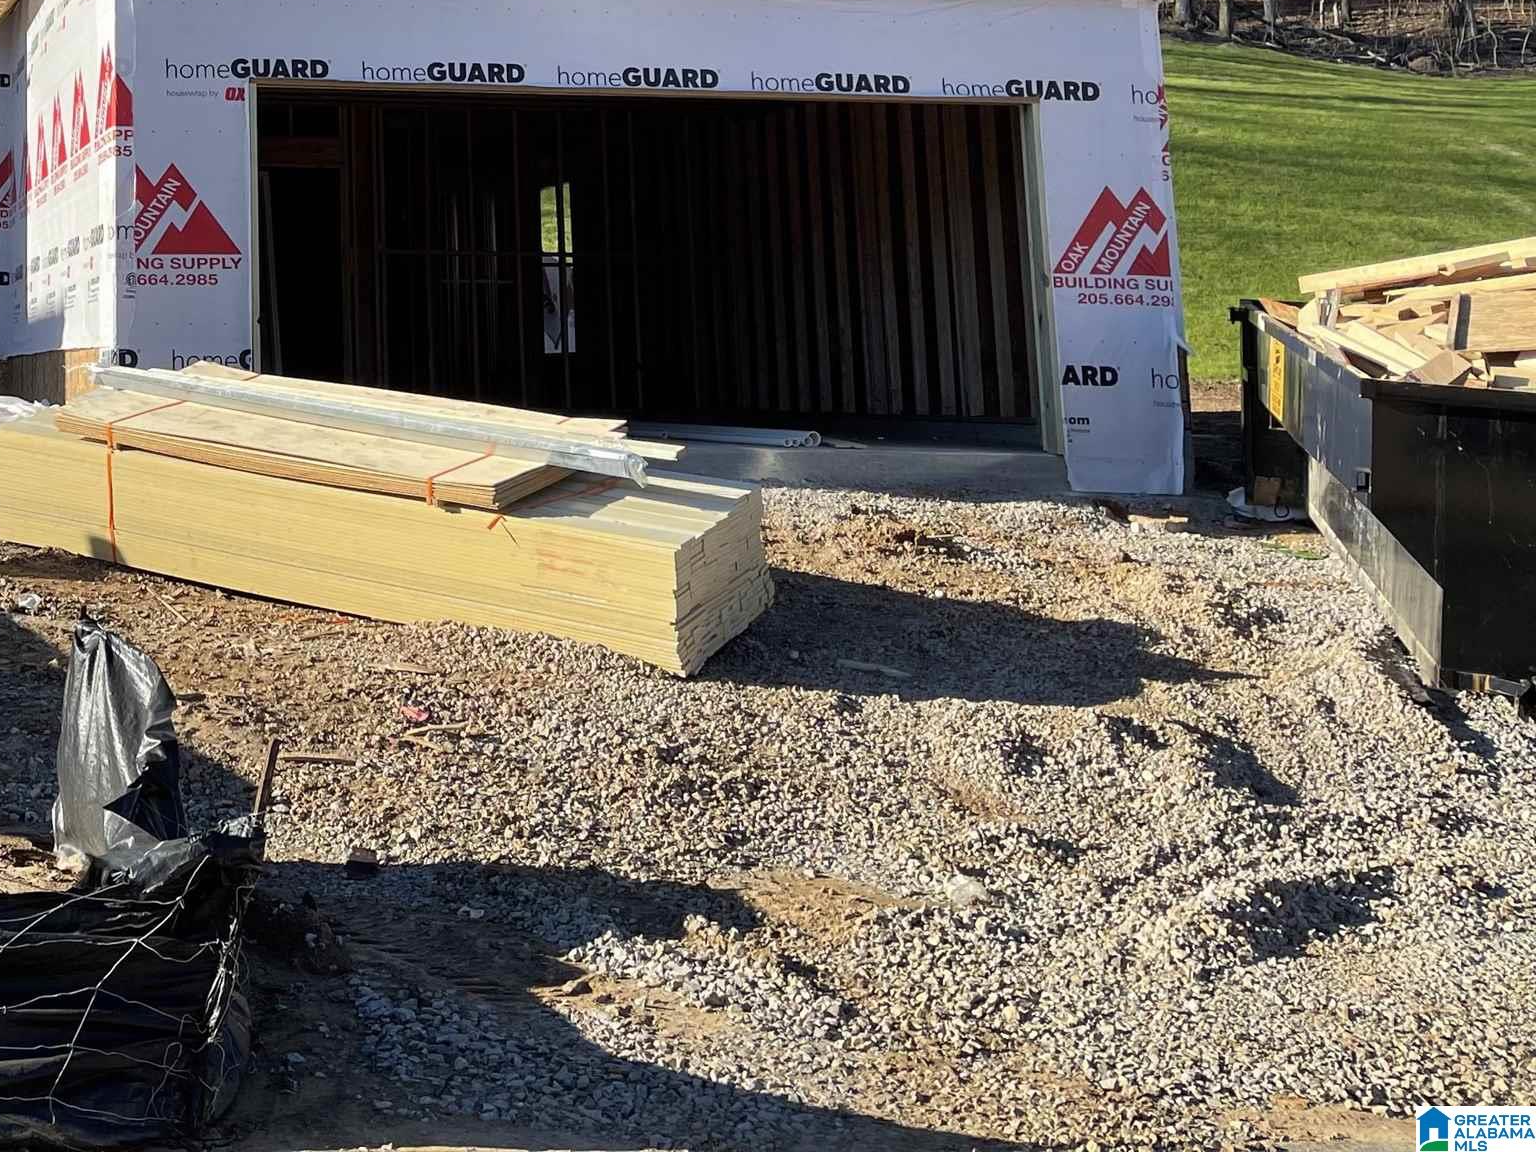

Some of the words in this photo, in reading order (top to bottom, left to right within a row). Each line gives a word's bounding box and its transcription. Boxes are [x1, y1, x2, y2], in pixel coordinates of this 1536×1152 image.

[165, 58, 330, 80] homeGUARD
[362, 61, 526, 83] homeGUARD
[557, 66, 719, 88] homeGUARD
[751, 72, 910, 93] homeGUARD
[942, 78, 1100, 101] homeGUARD
[224, 87, 245, 101] OX
[134, 177, 180, 246] OUNTAIN
[1097, 201, 1150, 273] MOUNTAIN
[170, 256, 242, 270] SUPPLY
[1061, 242, 1087, 272] OAK
[1053, 276, 1139, 291] BUILDING
